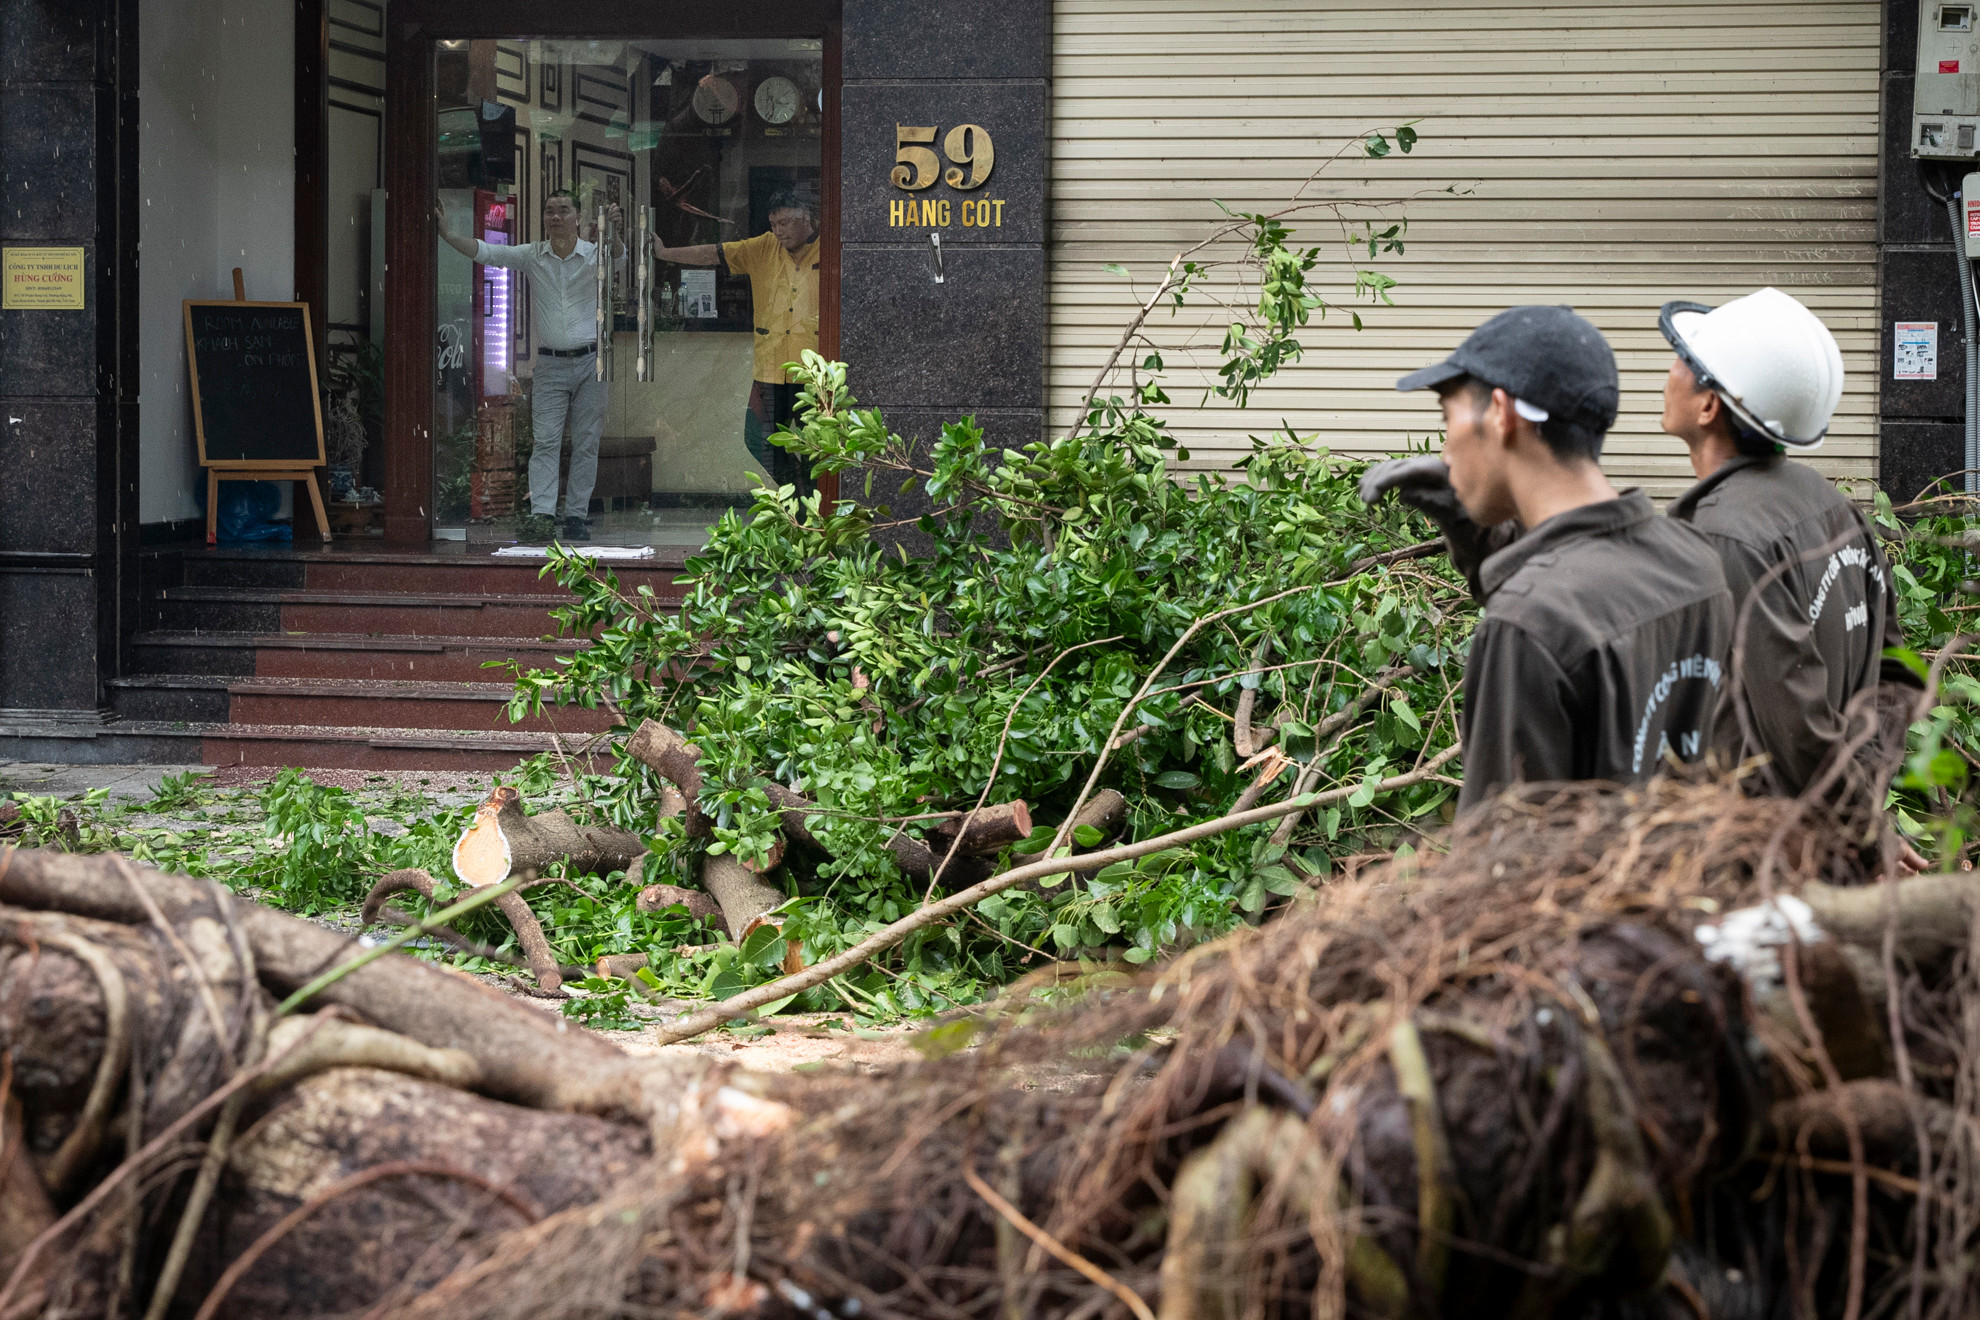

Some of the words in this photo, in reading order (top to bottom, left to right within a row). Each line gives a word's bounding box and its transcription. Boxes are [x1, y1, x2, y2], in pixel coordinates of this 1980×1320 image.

[891, 121, 995, 190] 59
[889, 192, 951, 228] HÀNG
[961, 191, 1006, 228] CÓT
[14, 272, 40, 283] HÙNG
[42, 272, 73, 283] CƯỜNG
